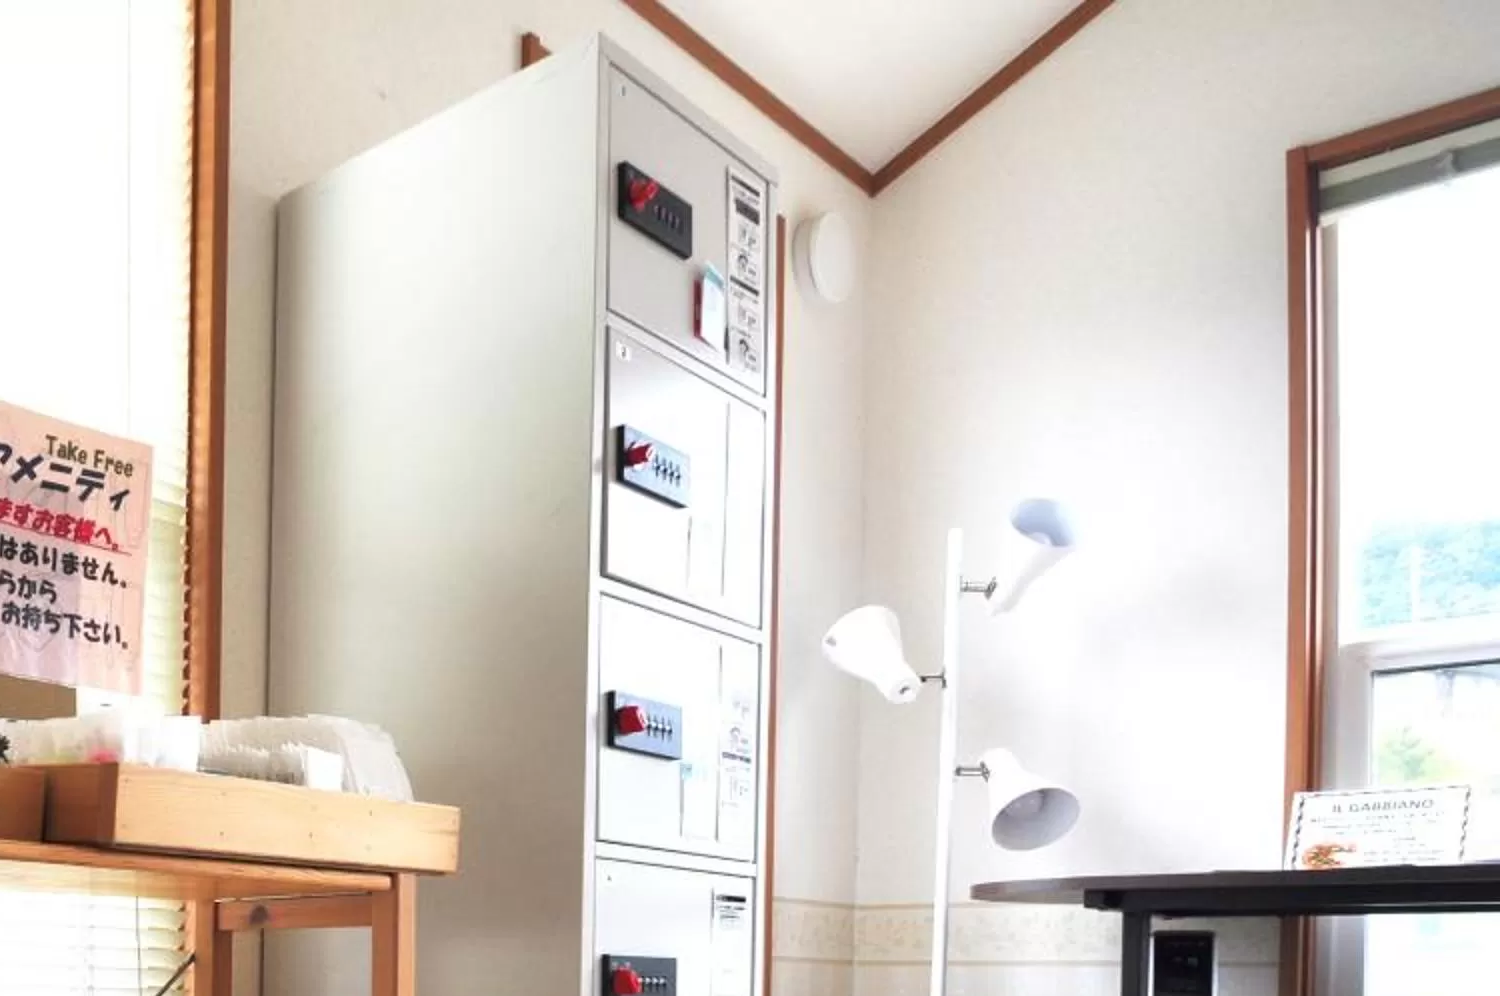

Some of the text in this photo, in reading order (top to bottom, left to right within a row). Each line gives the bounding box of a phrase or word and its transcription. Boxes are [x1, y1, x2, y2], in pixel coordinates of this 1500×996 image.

[45, 433, 134, 478] Take Free
[1348, 798, 1434, 813] GABBIANO
